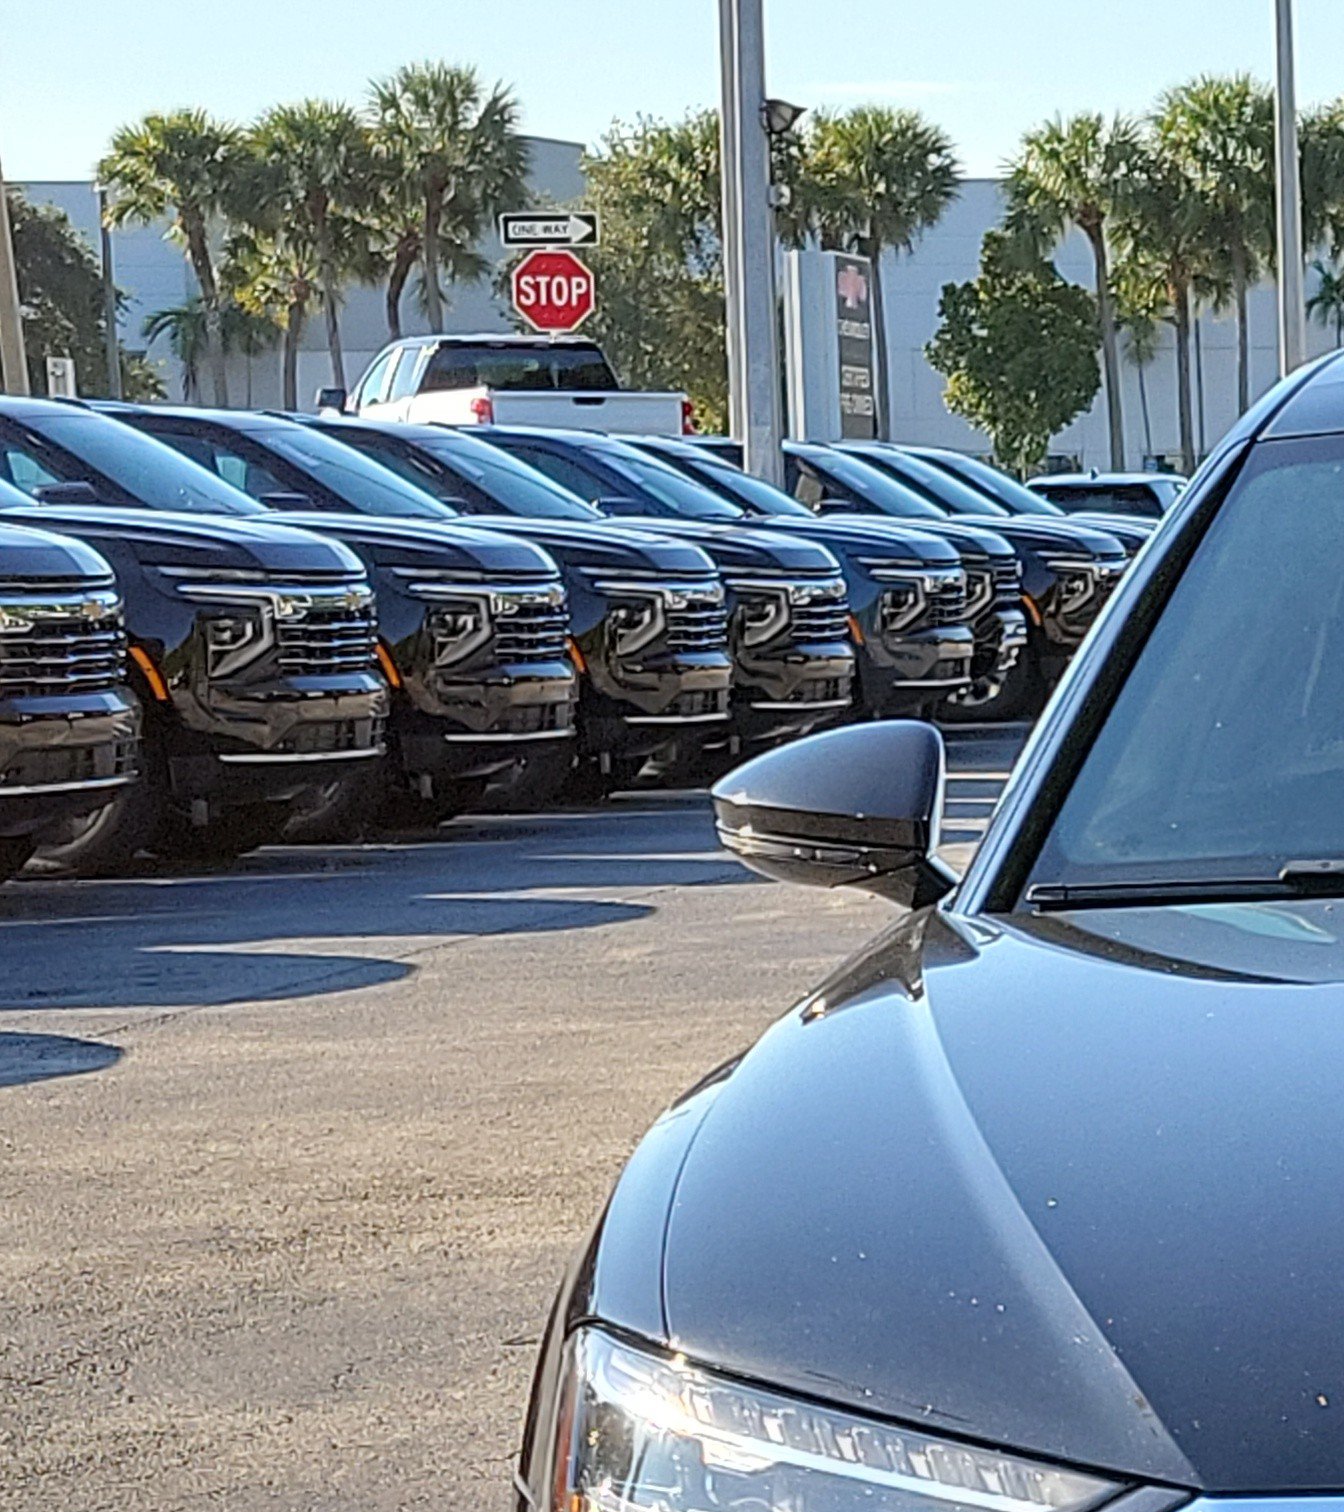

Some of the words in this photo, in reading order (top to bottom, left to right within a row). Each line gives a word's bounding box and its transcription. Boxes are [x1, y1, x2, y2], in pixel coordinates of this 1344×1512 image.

[512, 224, 538, 236] ONE
[542, 224, 569, 235] WAY
[519, 275, 588, 307] STOP
